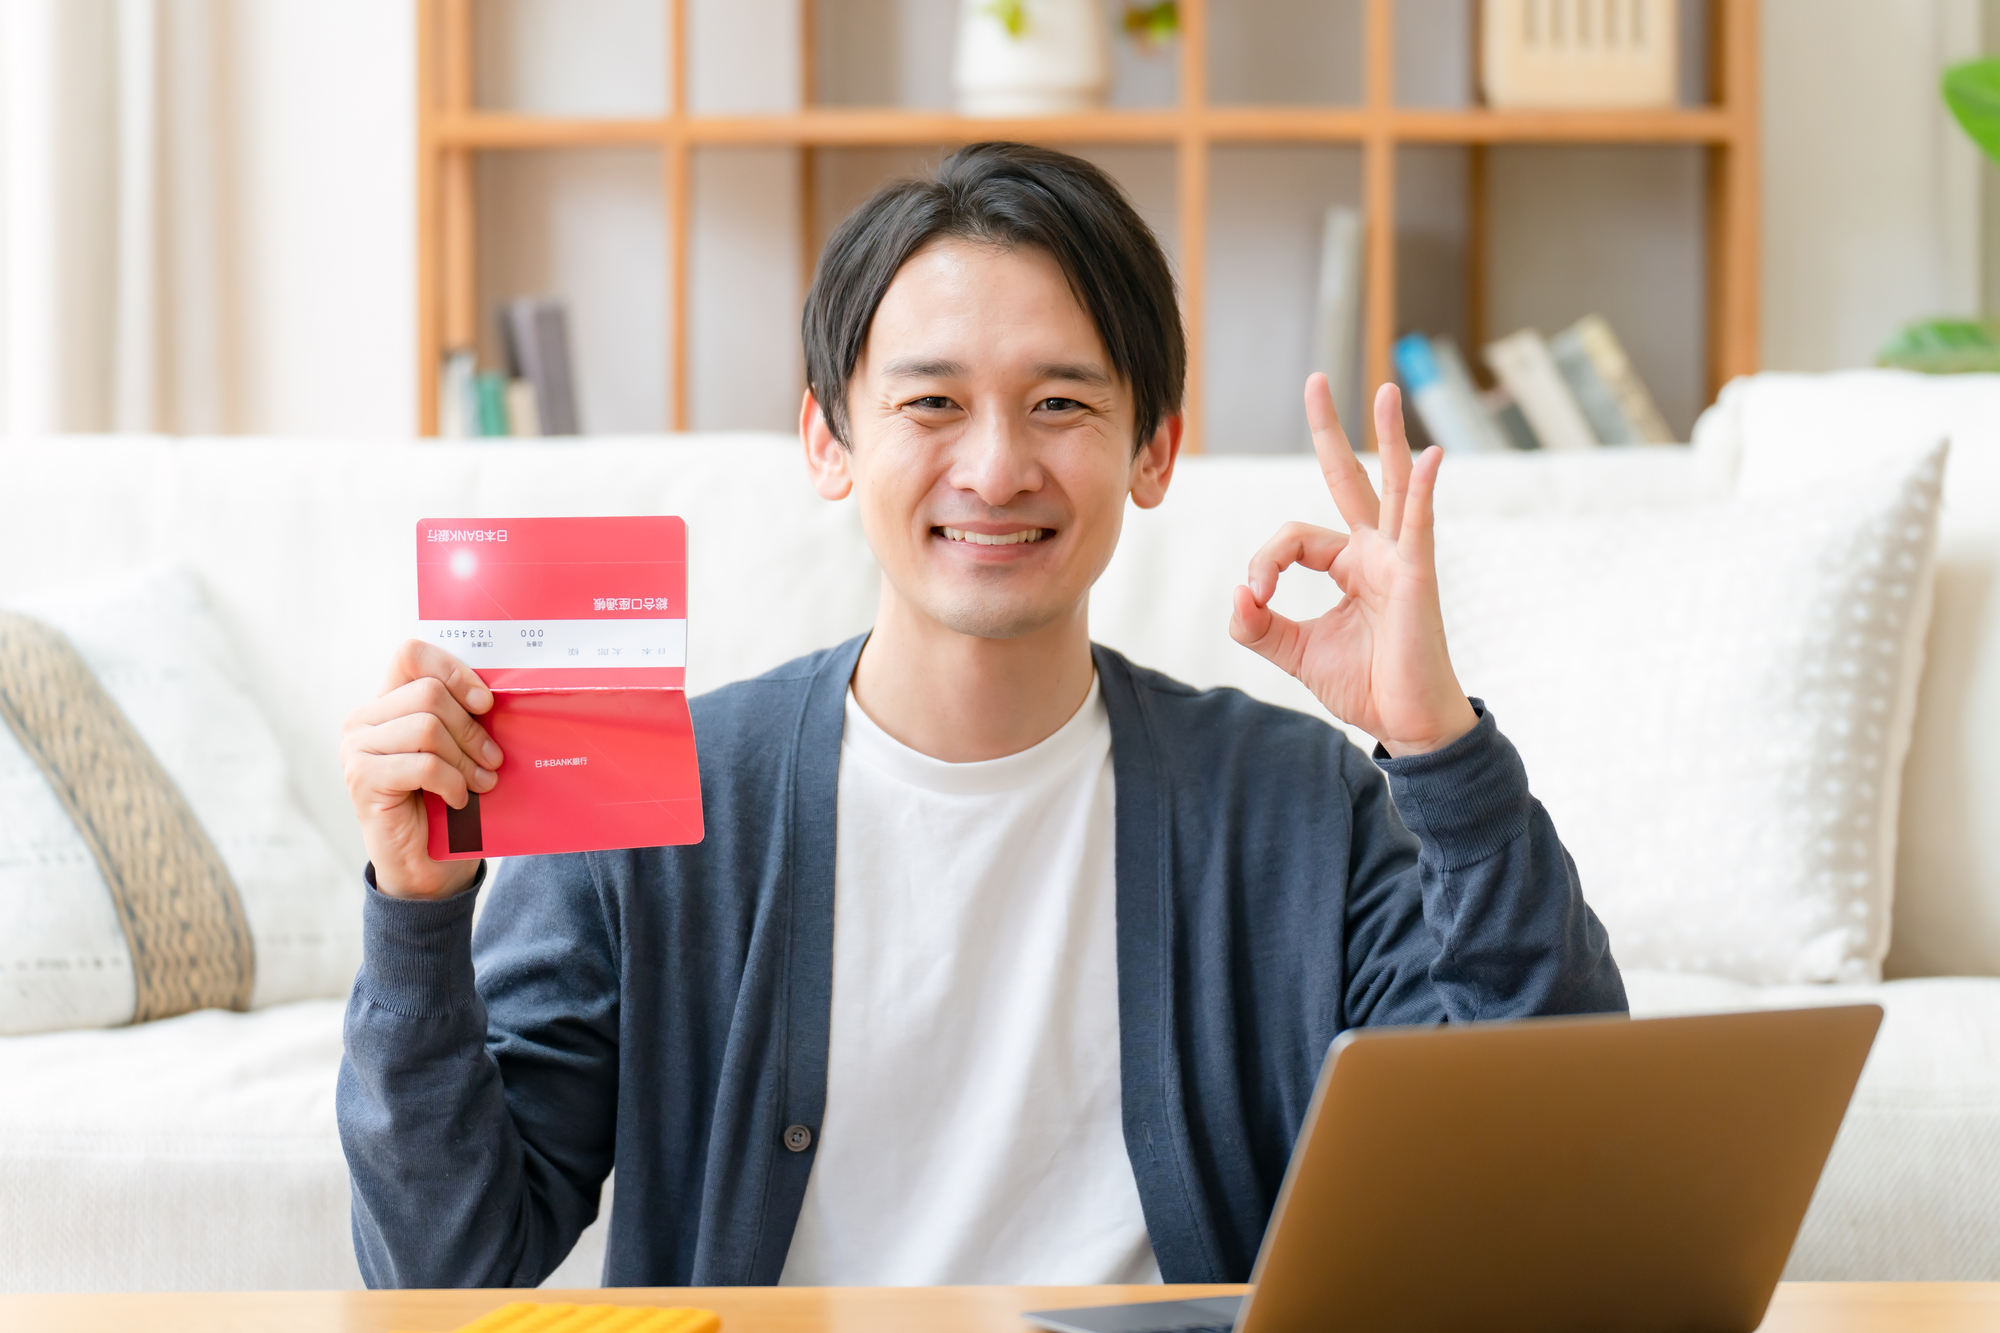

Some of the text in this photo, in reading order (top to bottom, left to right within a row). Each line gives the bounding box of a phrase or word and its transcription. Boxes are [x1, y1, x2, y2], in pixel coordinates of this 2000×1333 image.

[427, 529, 507, 542] 日本BANK銀行
[593, 597, 668, 611] 総合口座通帳
[439, 629, 492, 638] 1234567
[520, 629, 544, 638] 000
[535, 757, 587, 768] 日本BANK銀行
